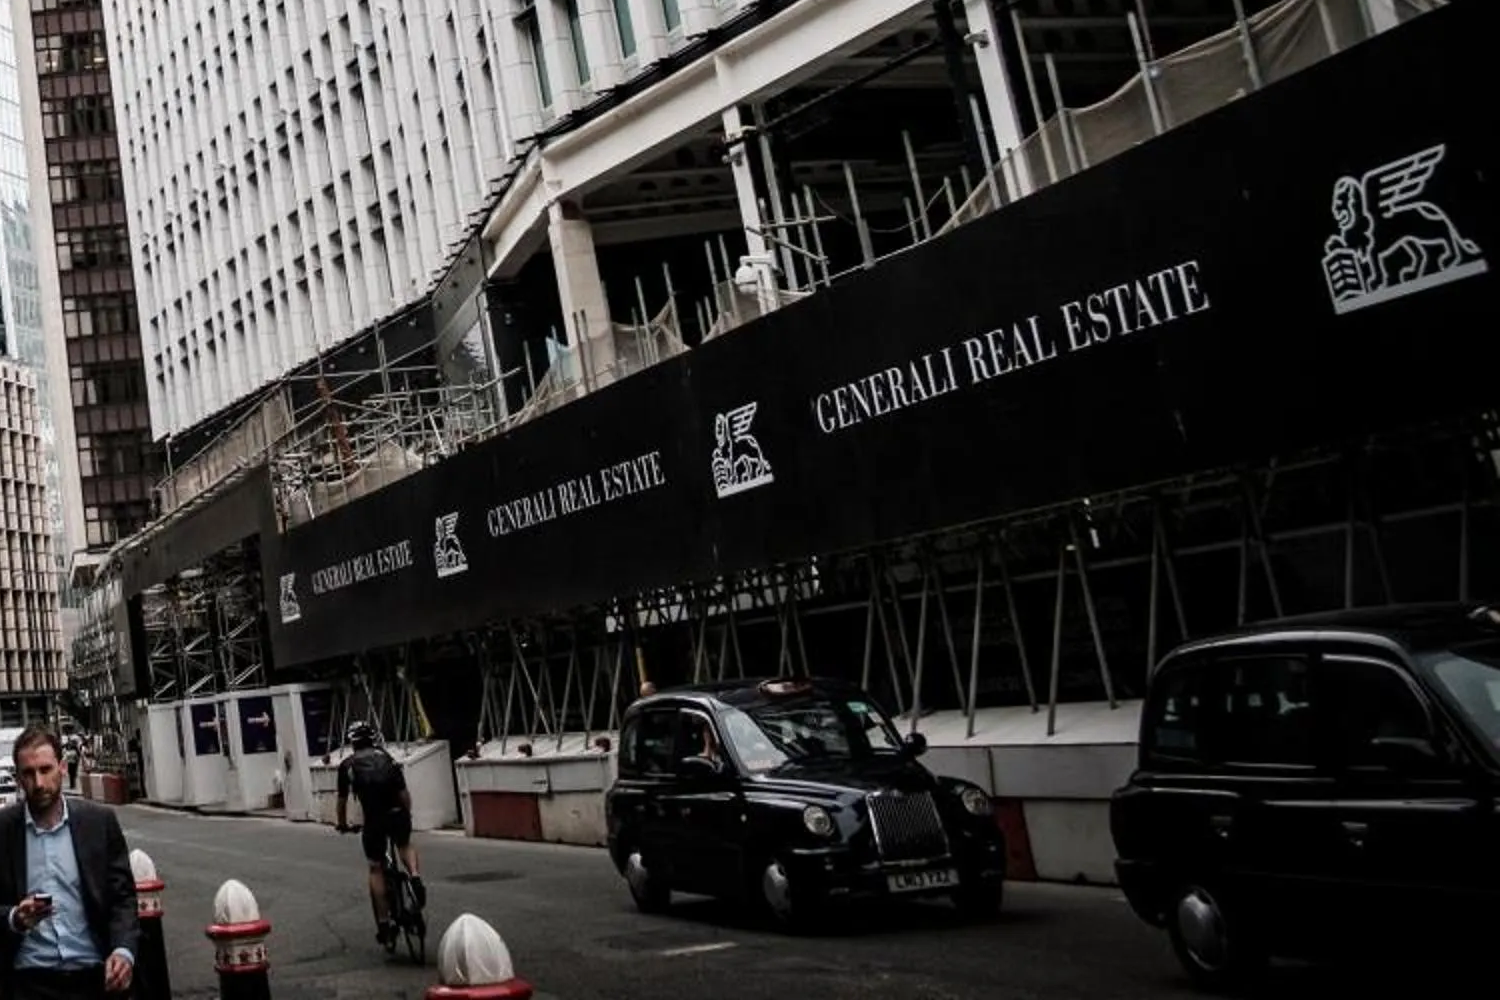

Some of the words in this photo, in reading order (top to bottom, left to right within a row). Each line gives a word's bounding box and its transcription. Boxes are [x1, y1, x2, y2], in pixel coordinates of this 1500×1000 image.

[815, 347, 960, 434] GENERALI
[962, 314, 1058, 384] REAL
[1059, 259, 1211, 353] ESTATE
[486, 486, 557, 538] GENERALI
[557, 473, 601, 516] REAL
[600, 450, 666, 502] ESTATE
[311, 559, 353, 596] GENERALI
[352, 552, 378, 583] REAL
[377, 538, 414, 575] ESTATE
